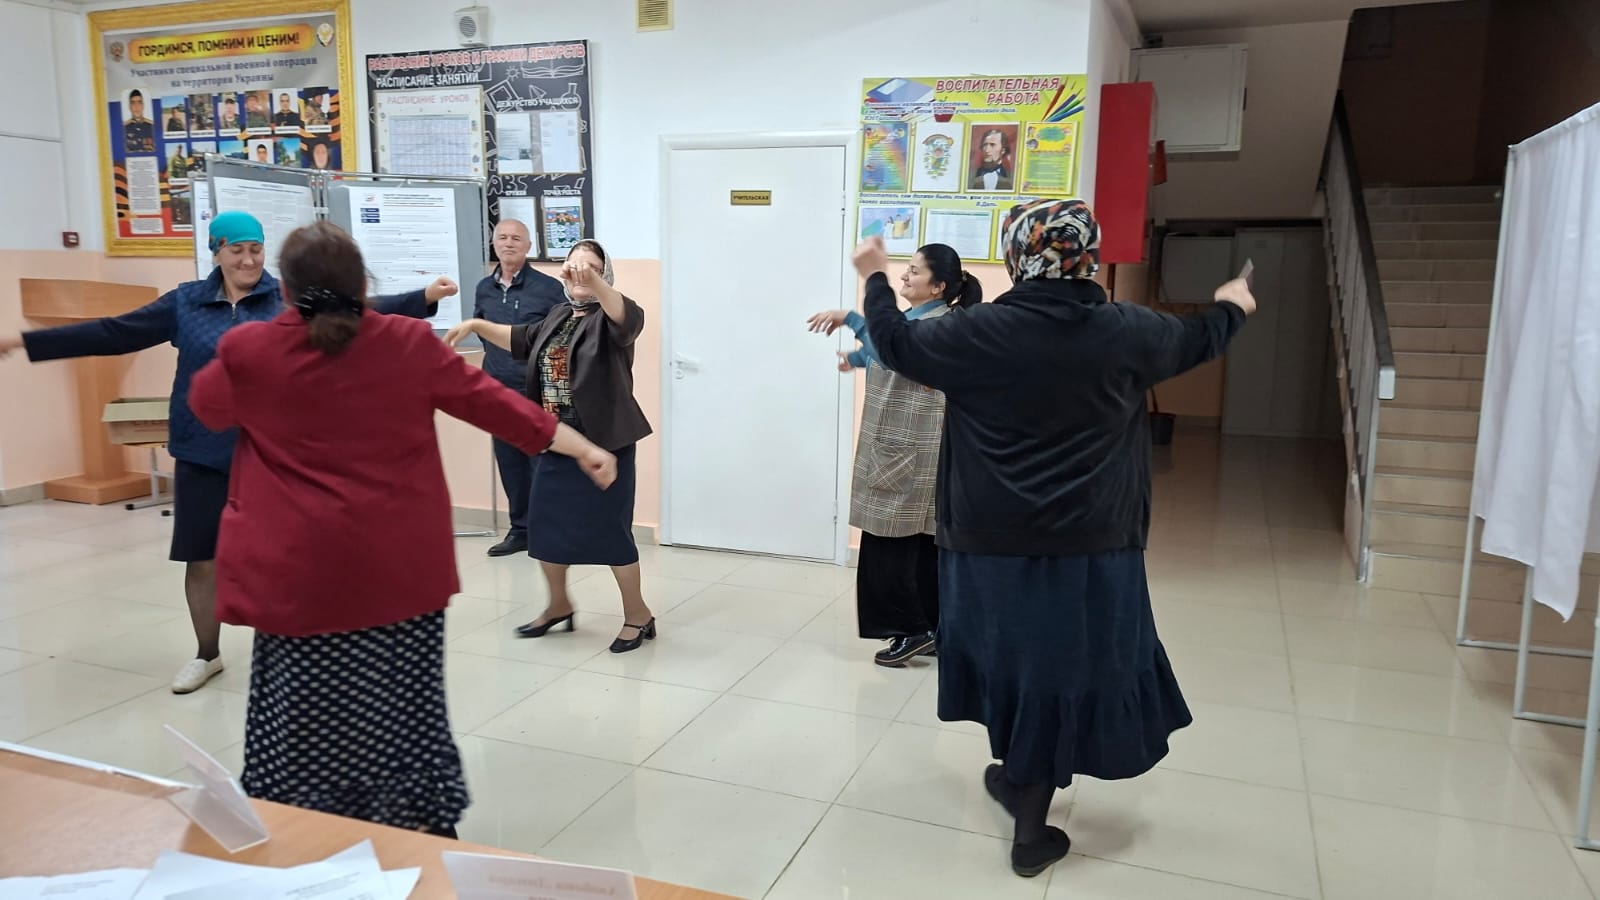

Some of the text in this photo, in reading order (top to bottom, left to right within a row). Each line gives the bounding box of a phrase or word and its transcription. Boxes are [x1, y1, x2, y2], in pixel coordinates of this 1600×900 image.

[138, 32, 300, 57] ГОРДИМСЯ, ПОМНИМ И ЦЕНИМ!
[367, 54, 430, 71] РАСПИСАНИЕ
[431, 50, 471, 67] УРОКОВ
[471, 51, 480, 65] И
[528, 43, 586, 63] ДЕЖУРСТВ
[130, 57, 317, 78] Участники специальной военной операции
[171, 73, 274, 88] на территории Украины
[376, 70, 479, 88] РАСПИСАНИЕ ЗАНЯТИЙ
[936, 77, 1060, 92] ВОСПИТАТЕЛЬНАЯ
[496, 97, 579, 108] ДЕЖУРСТВО УЧАЩИХСЯ
[986, 92, 1041, 105] РАБОТА
